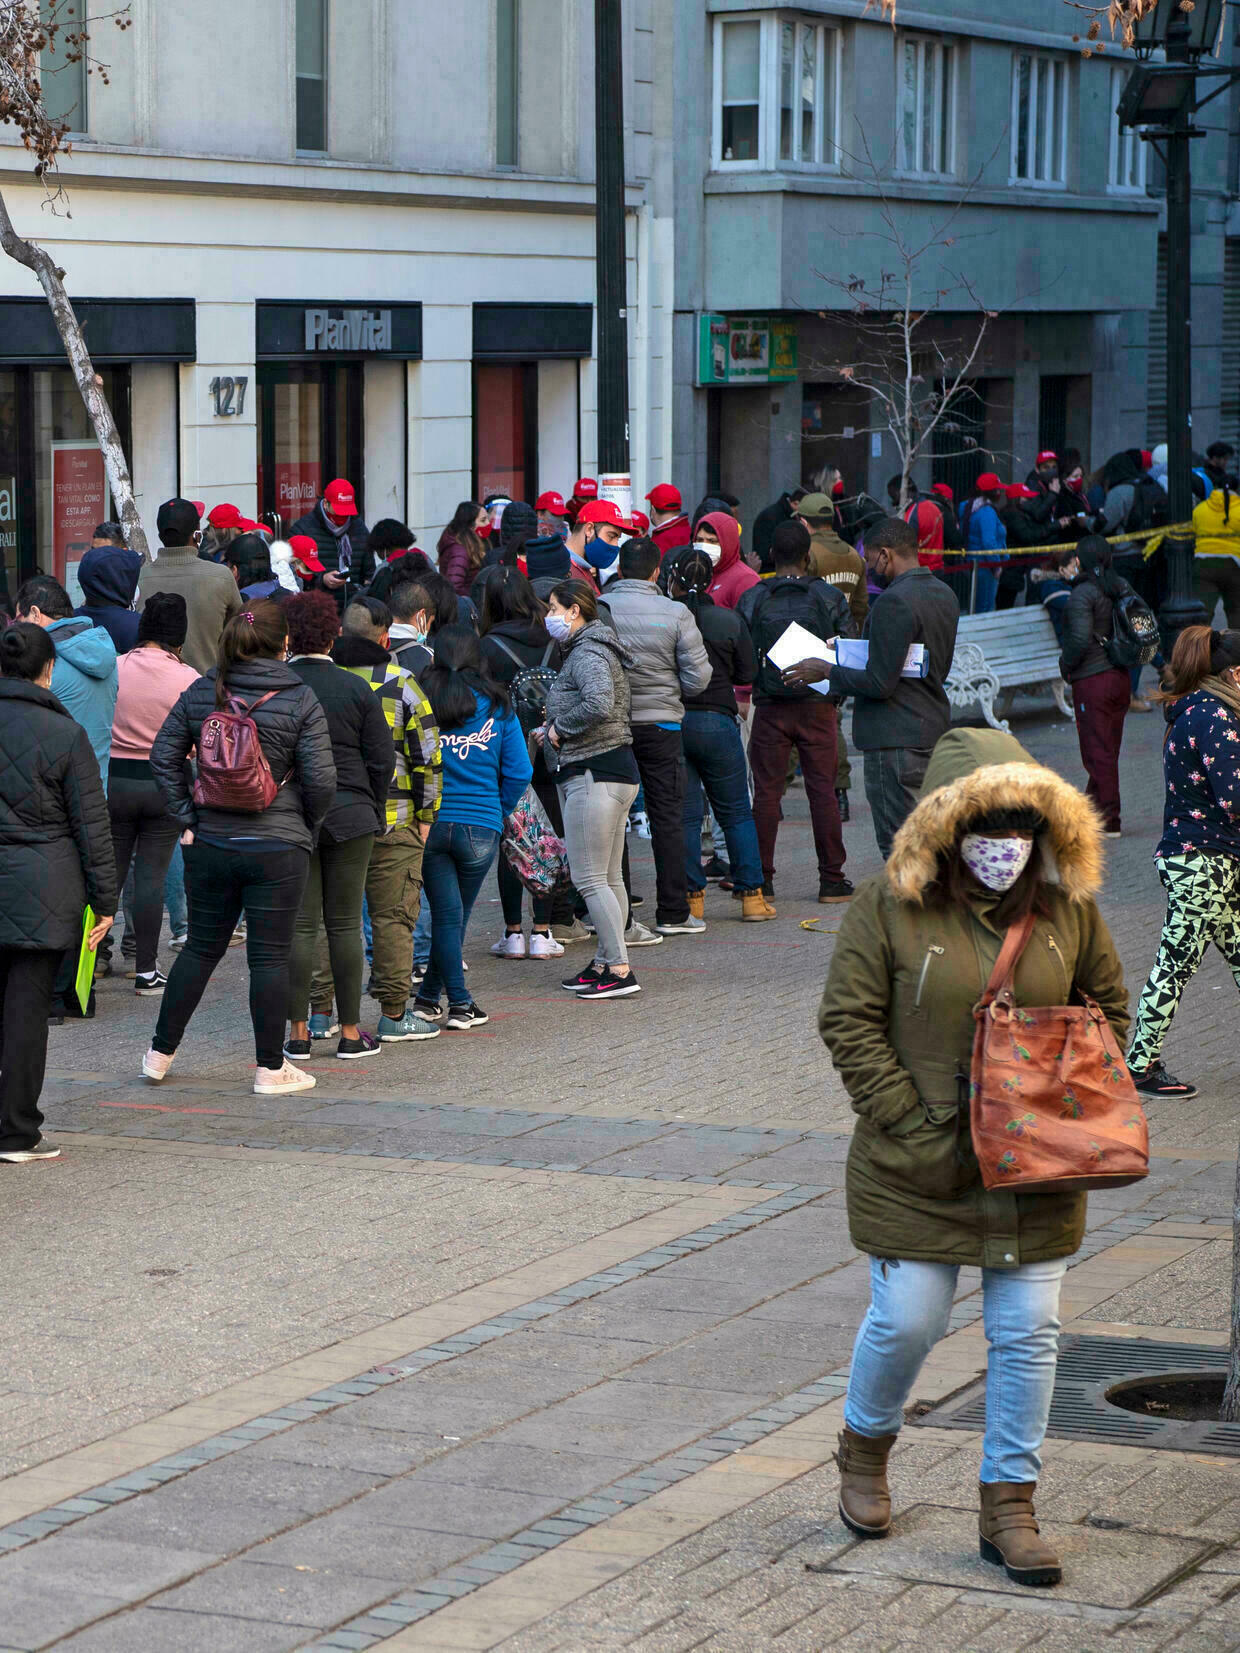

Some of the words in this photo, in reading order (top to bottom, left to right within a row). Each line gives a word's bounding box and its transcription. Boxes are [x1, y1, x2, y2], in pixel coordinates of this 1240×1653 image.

[304, 308, 392, 351] PlanVital
[209, 375, 249, 417] 127
[280, 481, 316, 501] PlanVital
[66, 506, 80, 516] ESTA
[821, 571, 860, 586] ARABINERO
[438, 717, 498, 760] ngels
